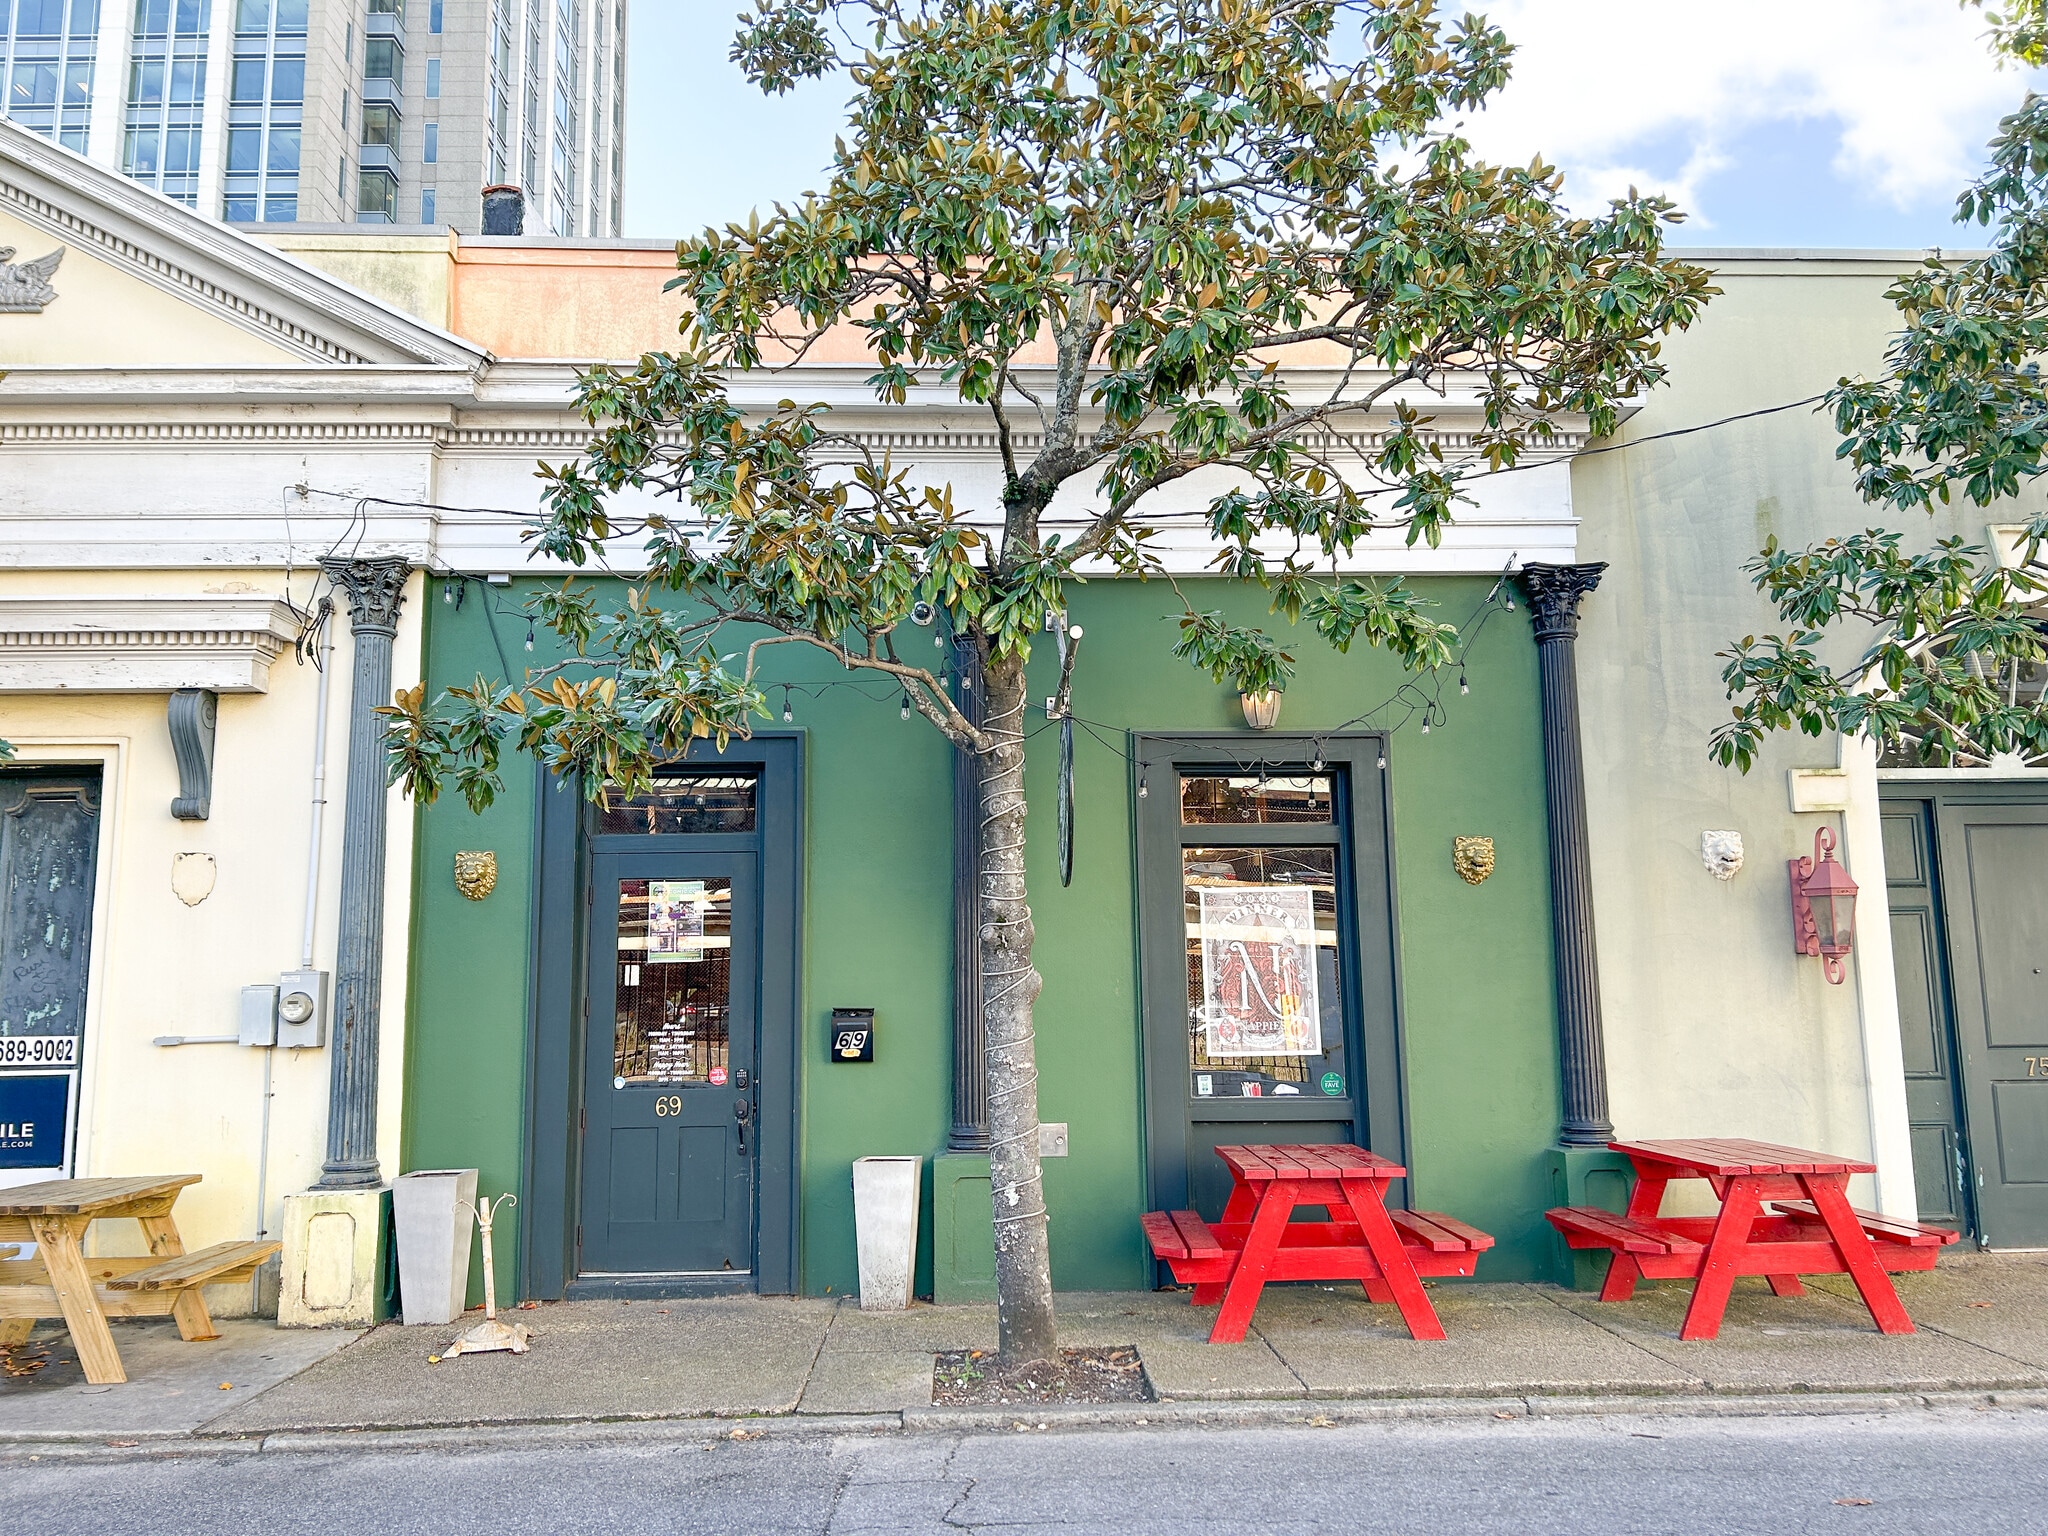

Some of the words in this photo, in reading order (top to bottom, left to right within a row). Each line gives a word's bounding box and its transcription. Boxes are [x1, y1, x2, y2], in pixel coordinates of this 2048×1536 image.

[1226, 905, 1288, 924] WINNER
[839, 1032, 864, 1047] 69
[653, 1062, 673, 1070] Happy
[2024, 1057, 2048, 1076] 75
[655, 1095, 682, 1117] 69
[0, 1123, 34, 1137] ILE
